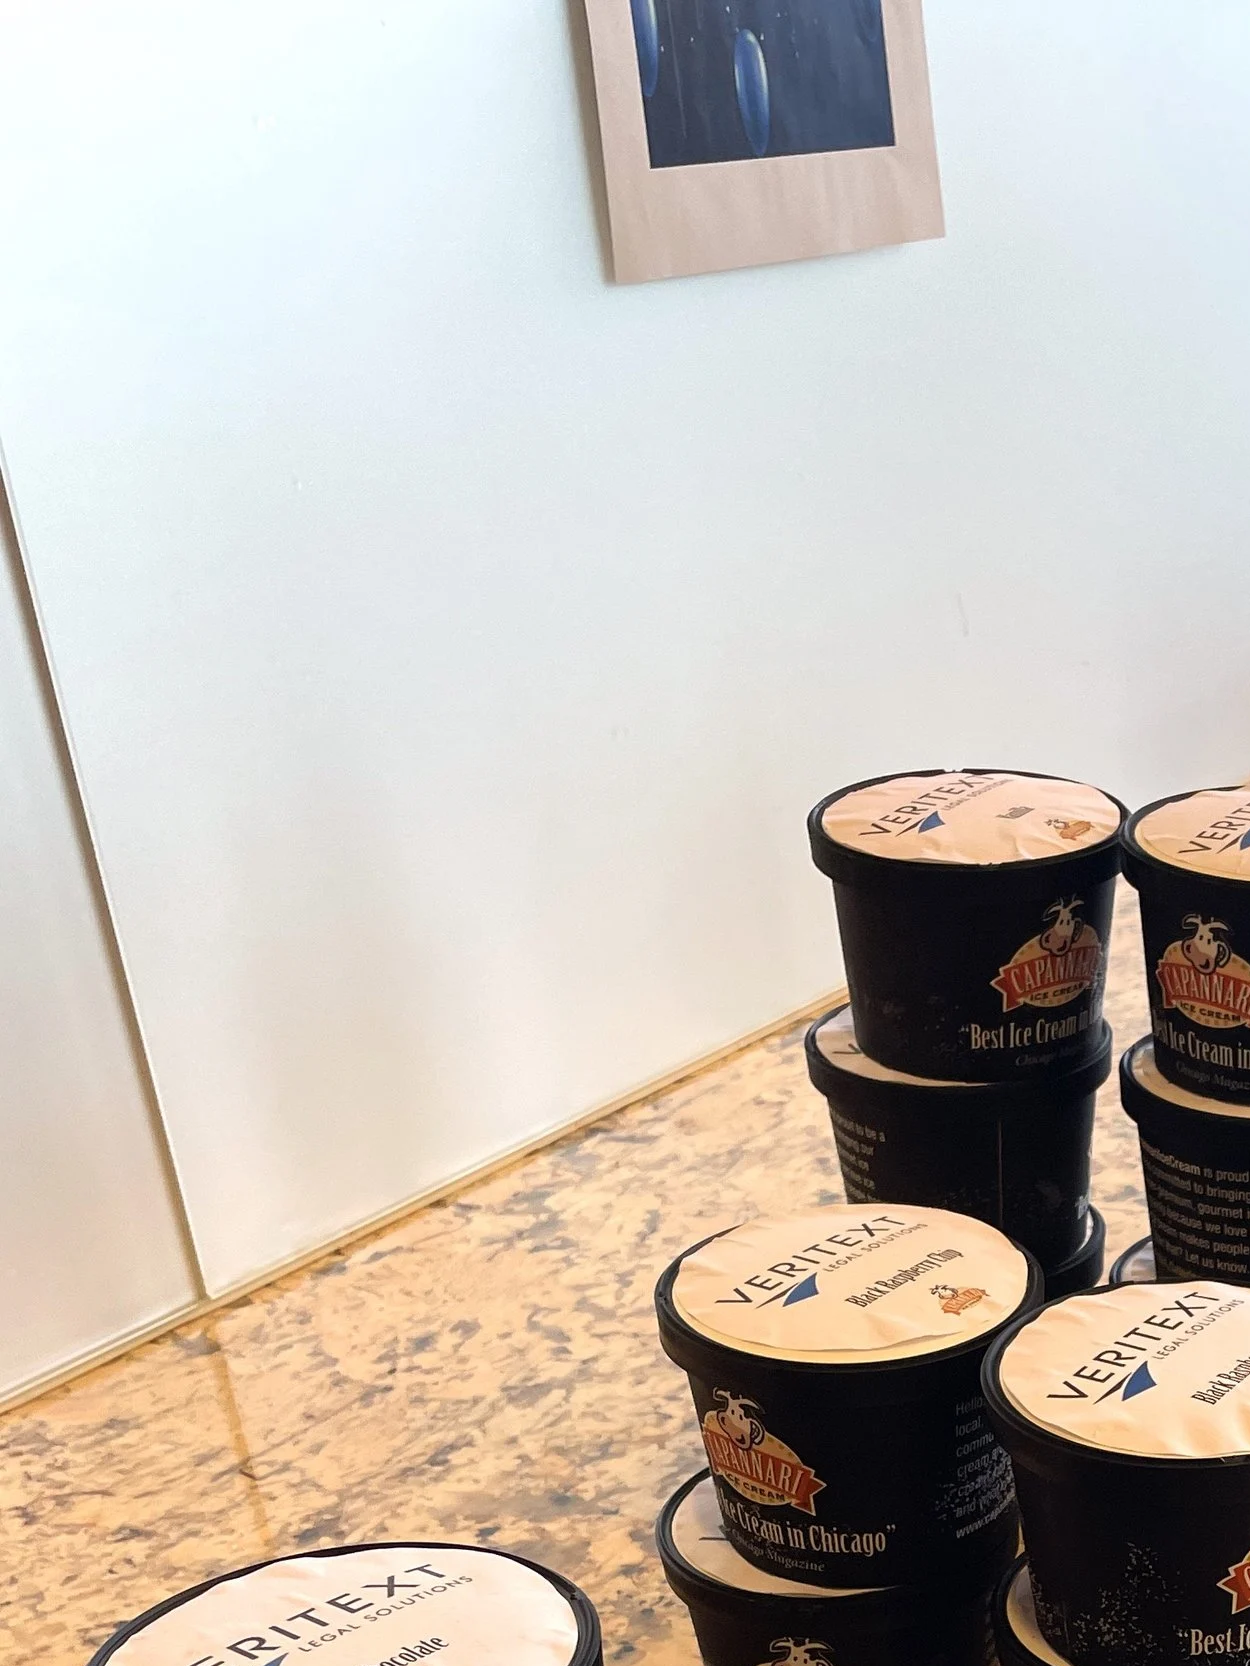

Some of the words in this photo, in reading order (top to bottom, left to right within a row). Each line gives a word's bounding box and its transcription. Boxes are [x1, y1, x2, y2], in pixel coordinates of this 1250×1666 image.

[1010, 1022, 1032, 1048] Ice
[1036, 1016, 1076, 1044] Cream
[1199, 1008, 1241, 1021] CREAM
[1187, 1031, 1234, 1069] Cream
[1216, 1170, 1249, 1183] proud
[715, 1216, 906, 1305] VERITEXT
[823, 1252, 863, 1272] LEGAL
[862, 1223, 929, 1253] SOLUTIONS
[845, 1287, 890, 1308] Black
[875, 1259, 942, 1290] Raspberry
[1046, 1291, 1220, 1399] VERITEXT
[1152, 1336, 1190, 1360] LEGAL
[1185, 1298, 1245, 1336] SOLUTIONS
[1191, 1380, 1236, 1405] Black
[743, 1482, 786, 1501] CREAM
[737, 1501, 785, 1545] Cream
[786, 1521, 806, 1550] in
[298, 1624, 361, 1652] LEGAL
[364, 1574, 474, 1622] SOLUTIONS
